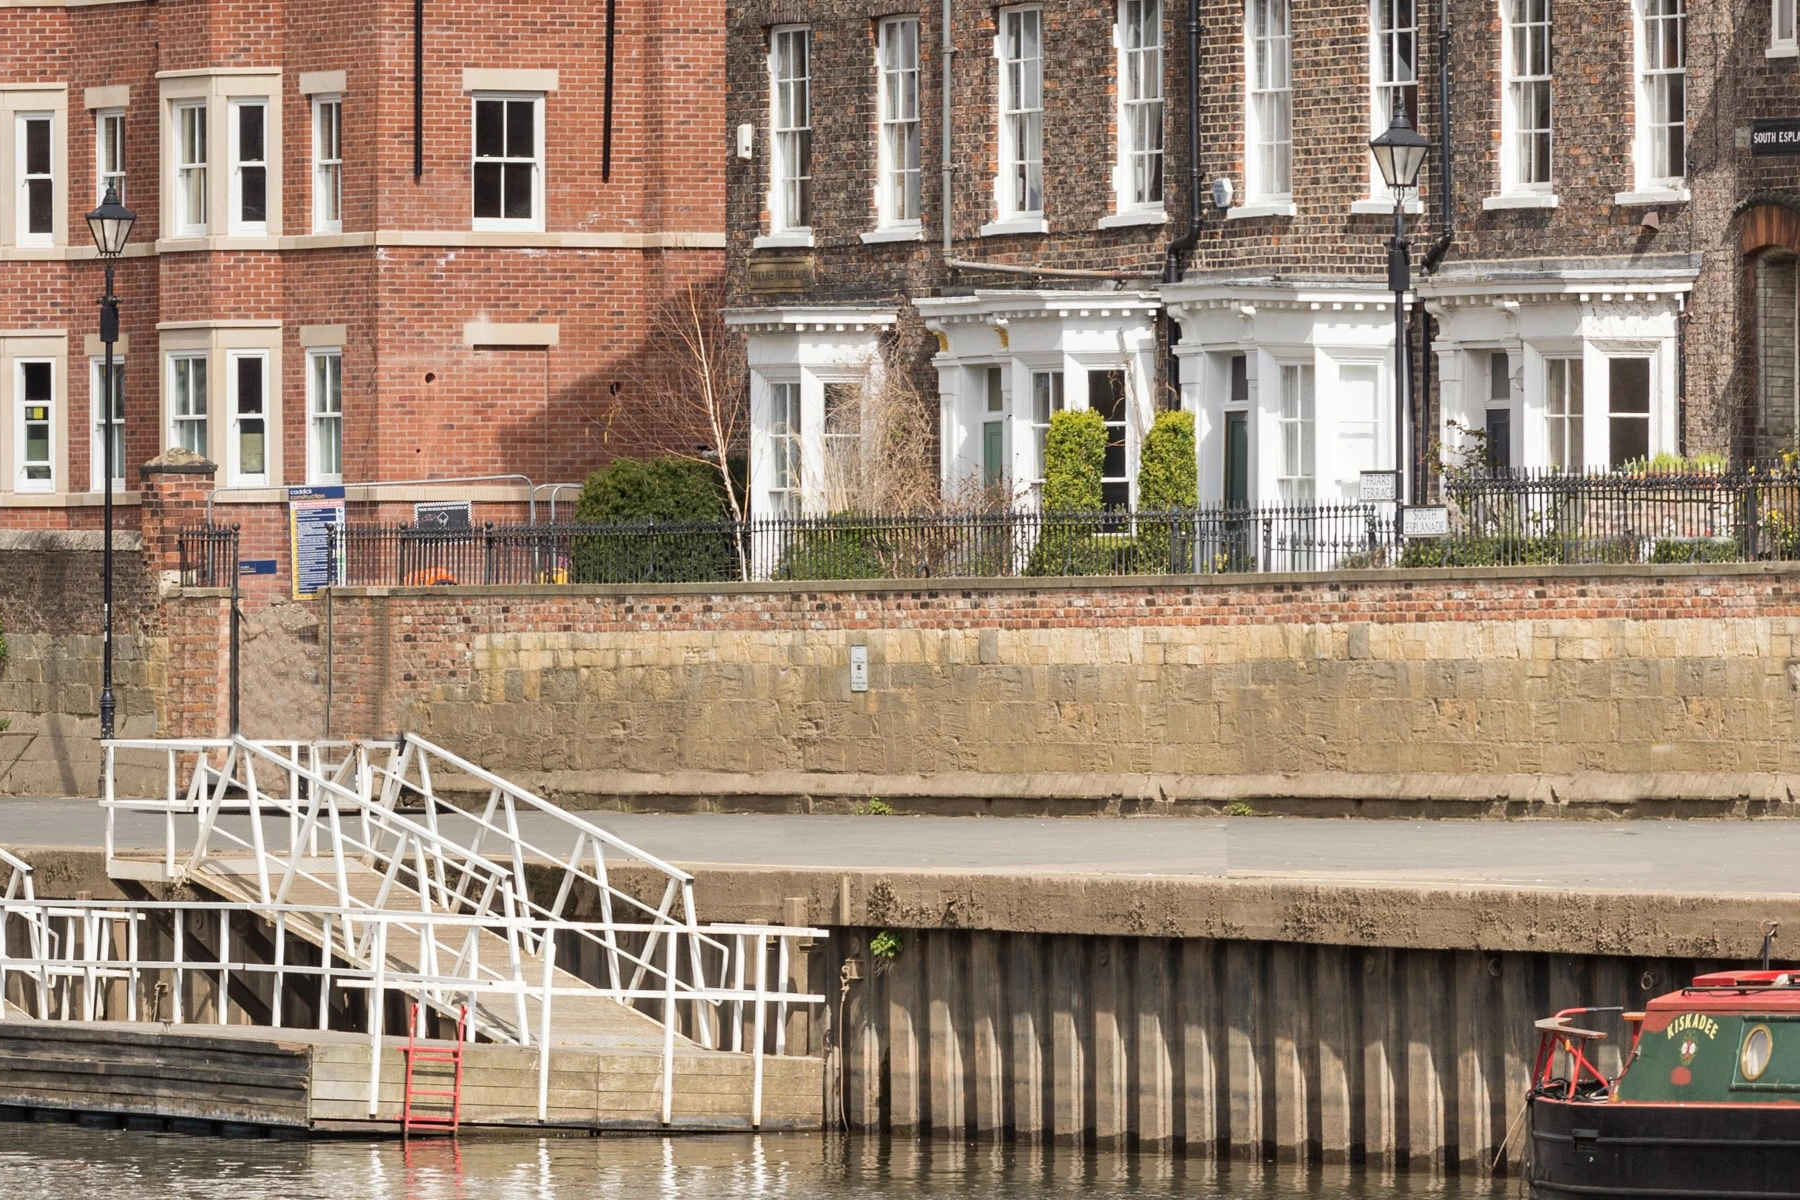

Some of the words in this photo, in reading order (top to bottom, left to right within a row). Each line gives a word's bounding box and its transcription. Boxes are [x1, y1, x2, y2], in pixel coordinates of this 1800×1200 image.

[1753, 131, 1776, 144] SOUTH
[1365, 474, 1390, 486] FRIARS
[1363, 487, 1394, 498] TERRACE
[1413, 508, 1437, 520] SOUTH
[1405, 521, 1445, 533] ESPLANADE
[1667, 1013, 1719, 1040] KISKADEE
